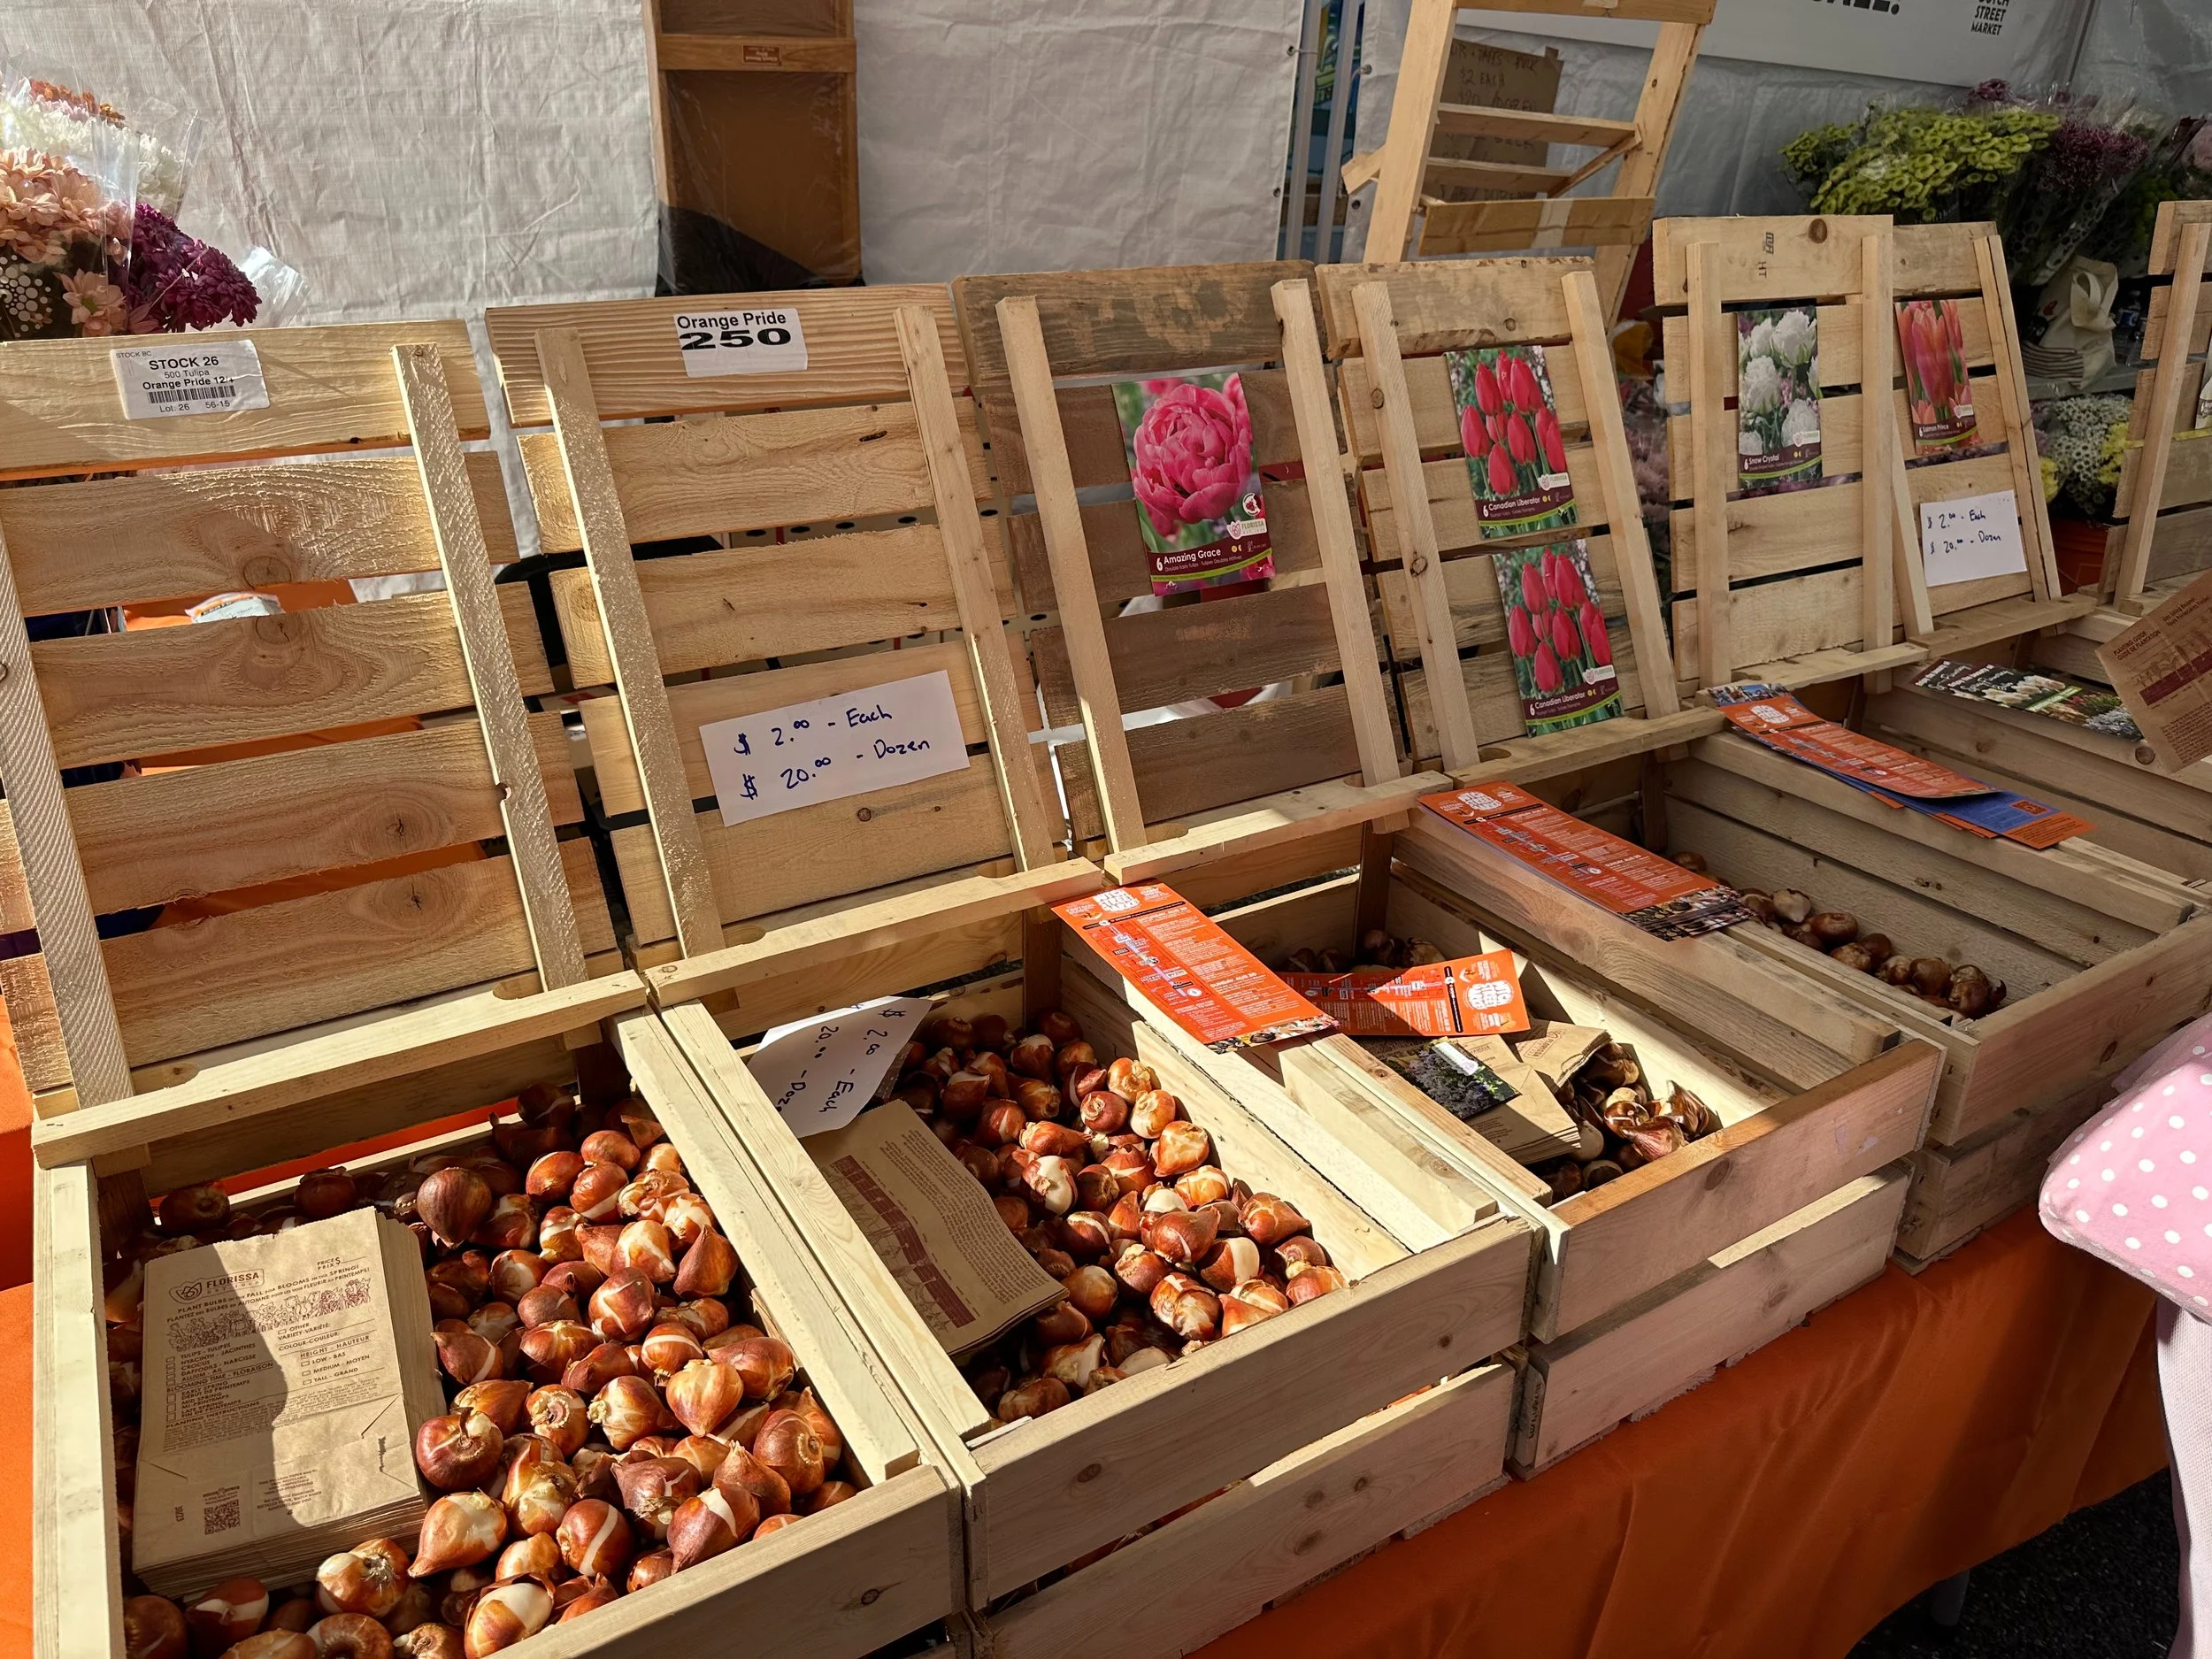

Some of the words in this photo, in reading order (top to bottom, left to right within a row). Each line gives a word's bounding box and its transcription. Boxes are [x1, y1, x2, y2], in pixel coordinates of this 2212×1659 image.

[1975, 5, 2006, 22] STREET
[1970, 21, 2002, 35] MARKET
[677, 316, 739, 330] Orange
[742, 311, 787, 326] Pride
[679, 327, 791, 350] 250
[149, 357, 199, 370] STOCK
[204, 356, 219, 366] 26
[183, 369, 210, 379] Tulipa
[142, 380, 181, 390] Orange
[184, 378, 211, 388] Pride
[205, 400, 231, 409] 56-15
[1919, 427, 1924, 437] 6
[1744, 459, 1748, 471] 6
[1763, 454, 1779, 463] Crystal
[1483, 505, 1488, 517] 6
[1488, 500, 1516, 511] Canadian
[1517, 496, 1540, 507] Liberator
[1970, 510, 1985, 521] Each
[1156, 557, 1164, 571] 6
[1164, 552, 1196, 565] Amazing
[1197, 549, 1221, 558] Grace
[1530, 703, 1535, 716] 6
[1535, 697, 1561, 709] Canadian
[1562, 691, 1586, 702] Liberator
[733, 733, 751, 756] $
[846, 704, 893, 728] Each
[740, 773, 758, 800] $
[872, 738, 931, 759] Dozen
[818, 1080, 854, 1113] Each
[335, 1256, 341, 1265] $
[178, 1303, 202, 1313] PLANT
[204, 1298, 227, 1307] BULBS
[278, 1278, 310, 1289] BLOOMS
[329, 1264, 359, 1276] SPRING!
[206, 1272, 259, 1289] FLORISSA
[166, 1312, 195, 1324] PLANTEZ
[206, 1304, 228, 1313] BULBES
[239, 1295, 270, 1306] AUTOMNE
[303, 1279, 326, 1289] FLEURIR
[335, 1267, 370, 1281] PRINTEMPS!
[289, 1322, 310, 1332] OTHER
[181, 1354, 214, 1365] HYACINTH
[221, 1343, 256, 1356] JACINTHES
[207, 1343, 231, 1353] TULIPES
[301, 1347, 327, 1358] HEIGHT
[336, 1335, 370, 1348] HAUTEUR
[181, 1363, 218, 1376] DAFFODILS
[223, 1354, 257, 1365] NARCISSE
[181, 1360, 211, 1371] CROCUS
[313, 1363, 340, 1373] MEDIUM
[347, 1355, 370, 1365] MOYEN
[334, 1368, 358, 1377] GRAND
[166, 1379, 208, 1393] BLOOMING
[233, 1363, 273, 1376] FLORAISON
[182, 1372, 205, 1381] ALLIUM
[204, 1381, 228, 1390] SPRING
[214, 1380, 250, 1392] PRINTEMPS
[197, 1393, 223, 1402] SPRING
[205, 1400, 242, 1412] PRINTEMPS
[166, 1417, 204, 1428] PLANTING
[206, 1401, 260, 1417] INSTRUCTIONS
